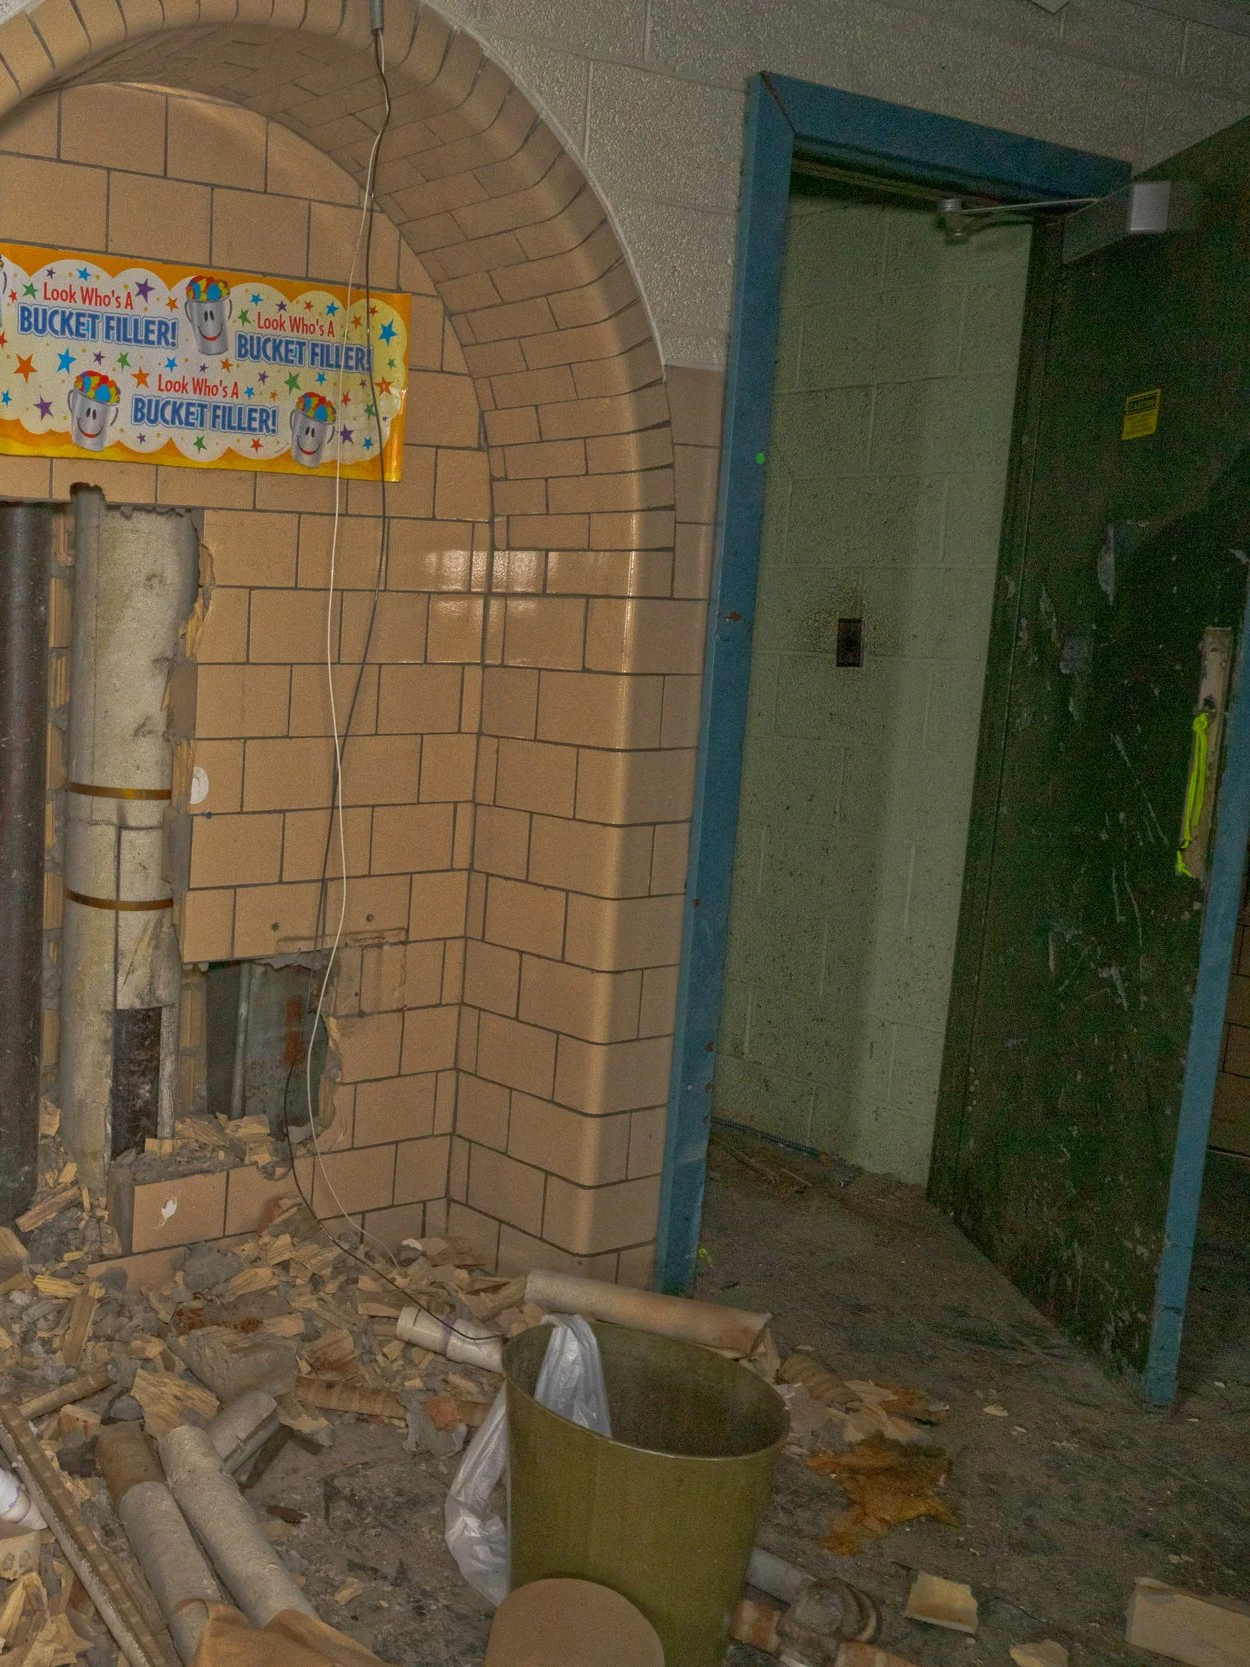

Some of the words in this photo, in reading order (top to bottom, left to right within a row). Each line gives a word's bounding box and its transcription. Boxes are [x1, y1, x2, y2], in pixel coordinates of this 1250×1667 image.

[43, 281, 77, 304] Look
[80, 285, 122, 309] Who's
[124, 291, 134, 310] A
[19, 304, 100, 340] BUCKET
[104, 314, 178, 348] FILLER!
[257, 311, 287, 332] Look
[289, 315, 325, 337] Who's
[327, 320, 335, 338] A
[236, 332, 307, 366] BUCKET
[309, 341, 373, 374] FILLER!
[157, 373, 189, 394] Look
[191, 377, 228, 398] Who's
[230, 381, 239, 399] A
[132, 396, 209, 429] BUCKET
[211, 404, 278, 435] FILLER!
